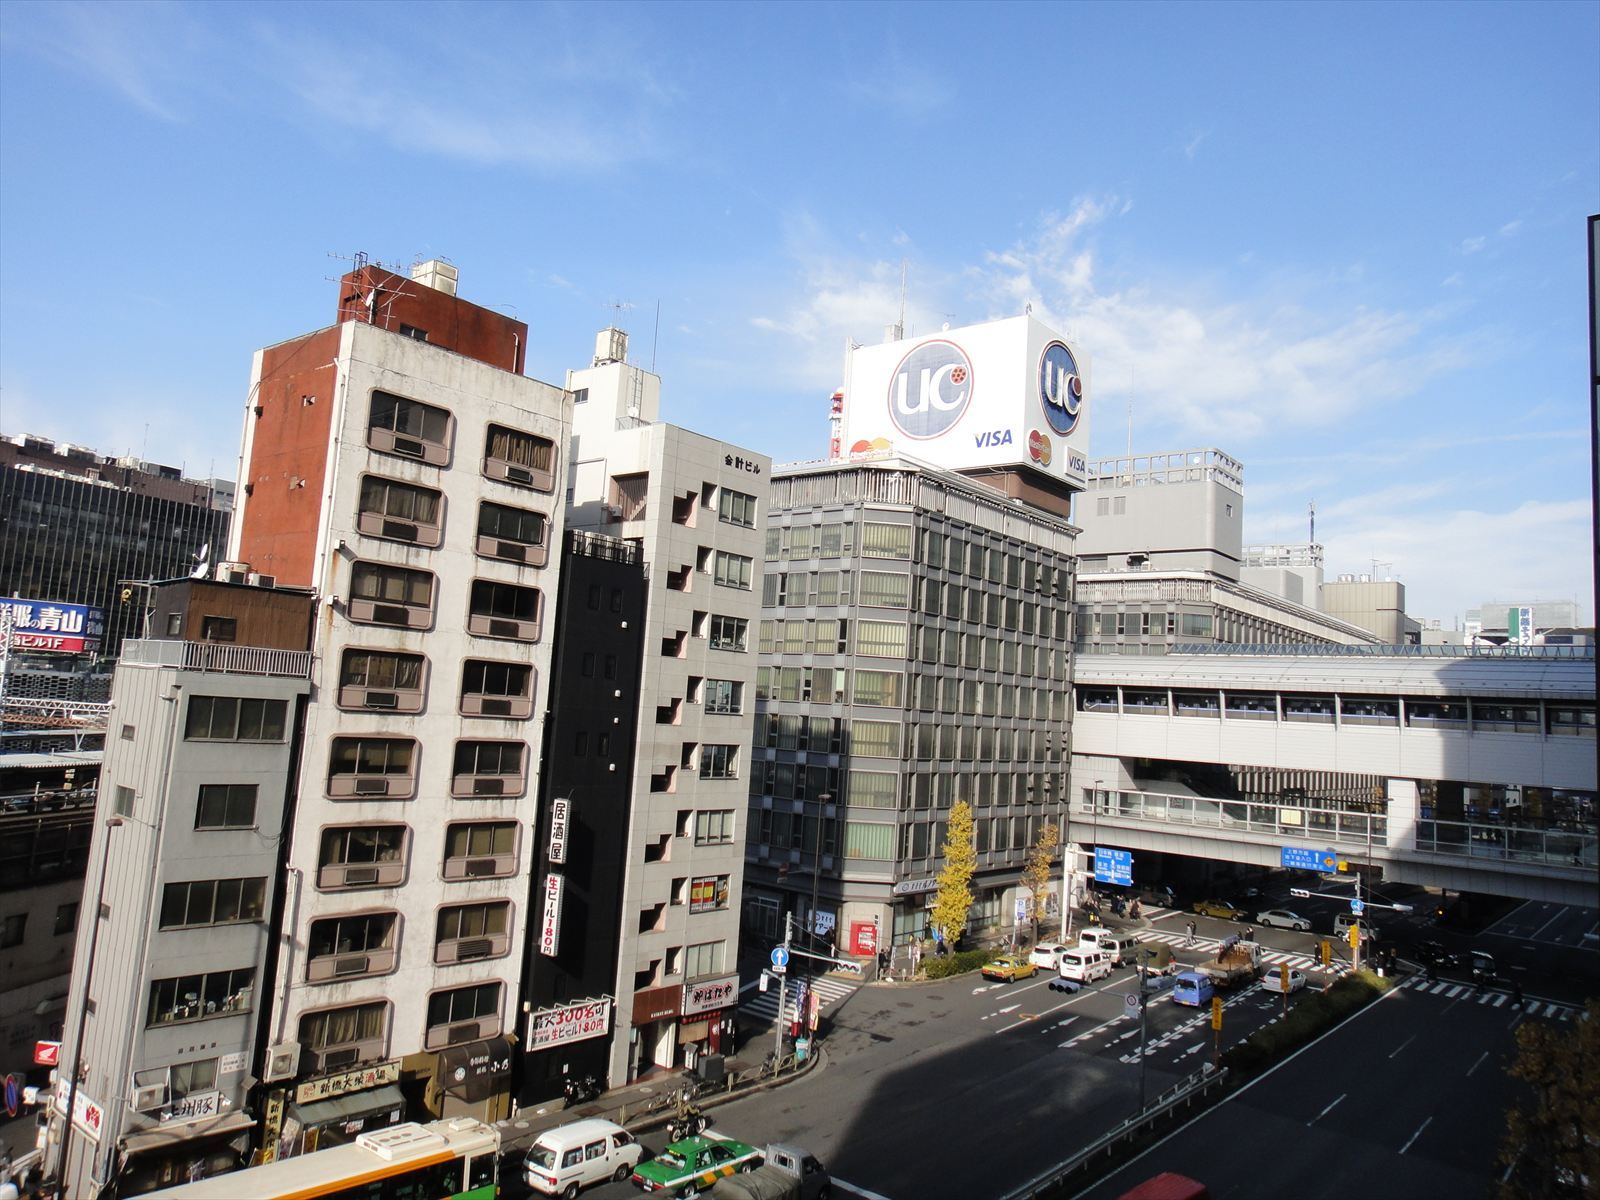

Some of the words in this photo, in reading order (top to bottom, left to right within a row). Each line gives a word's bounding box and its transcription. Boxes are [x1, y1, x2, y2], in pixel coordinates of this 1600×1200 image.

[975, 429, 1013, 448] VISA
[1069, 455, 1085, 473] VISA
[551, 802, 565, 861] 居酒屋
[543, 876, 558, 955] 生ビール180円
